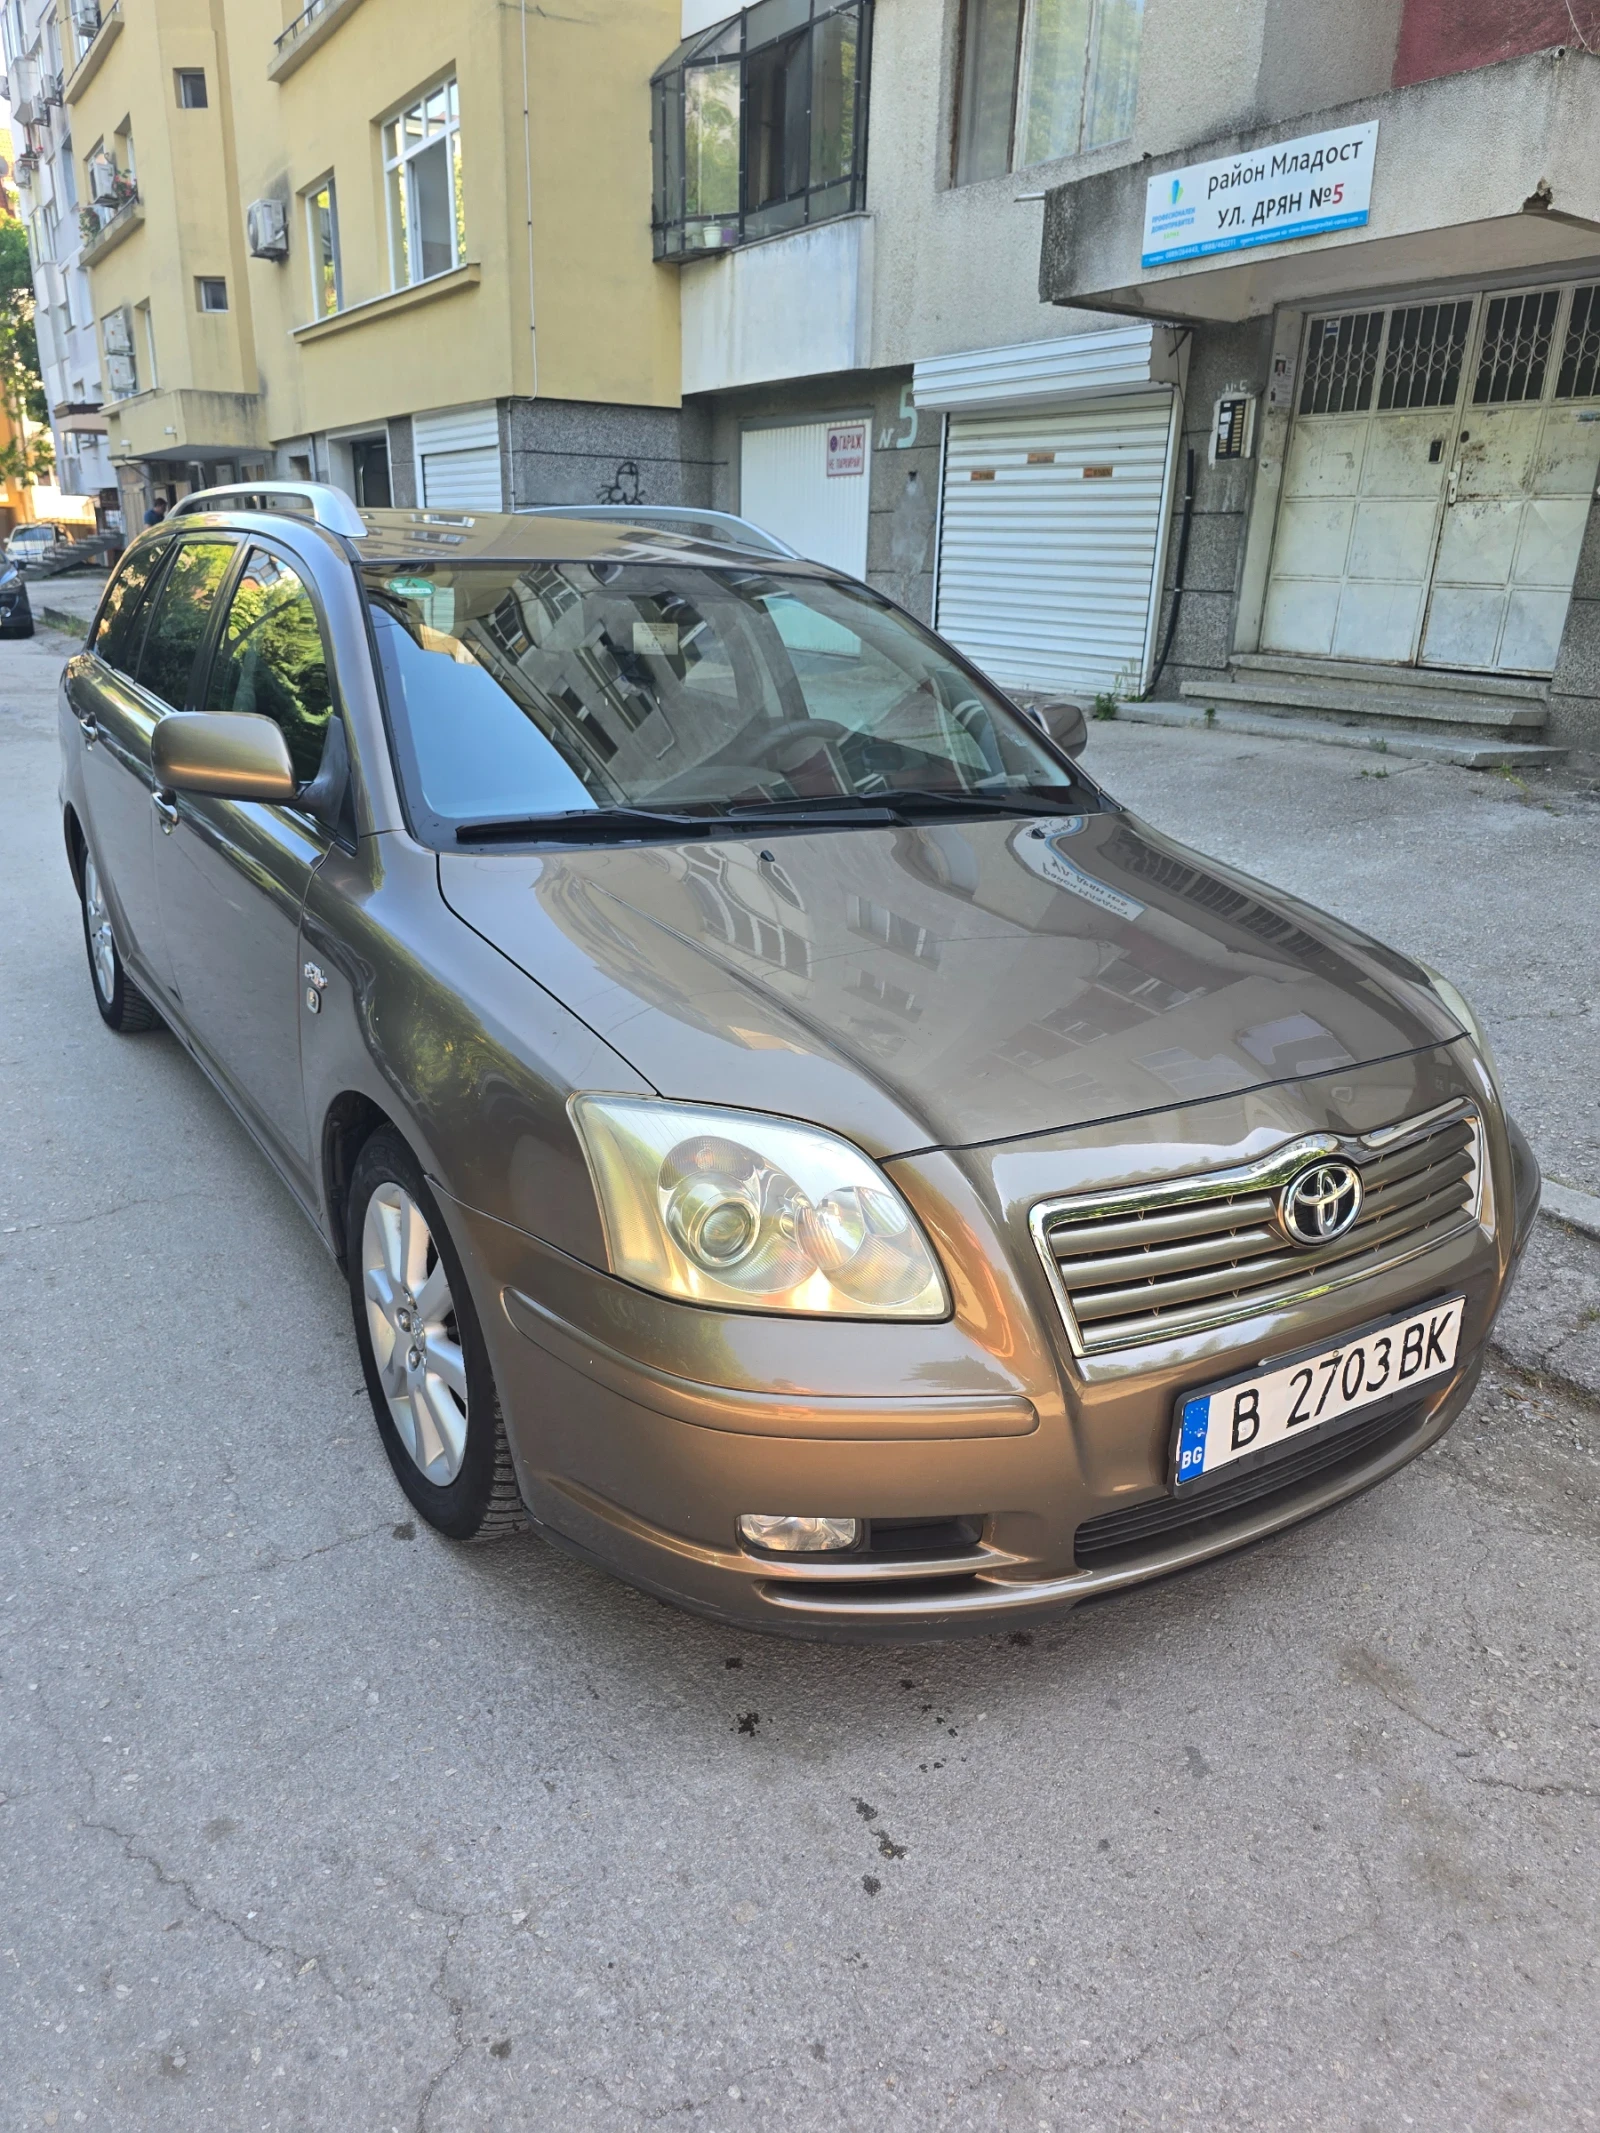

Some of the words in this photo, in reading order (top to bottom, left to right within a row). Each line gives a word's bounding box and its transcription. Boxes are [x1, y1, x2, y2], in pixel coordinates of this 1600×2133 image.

[1208, 162, 1265, 200] район
[1271, 141, 1363, 178] Младост
[1252, 192, 1303, 227] ДРЯН
[839, 434, 862, 451] ГАРАЖ
[1230, 1388, 1260, 1452] B
[1286, 1337, 1392, 1430] 2703
[1181, 1446, 1202, 1469] BG
